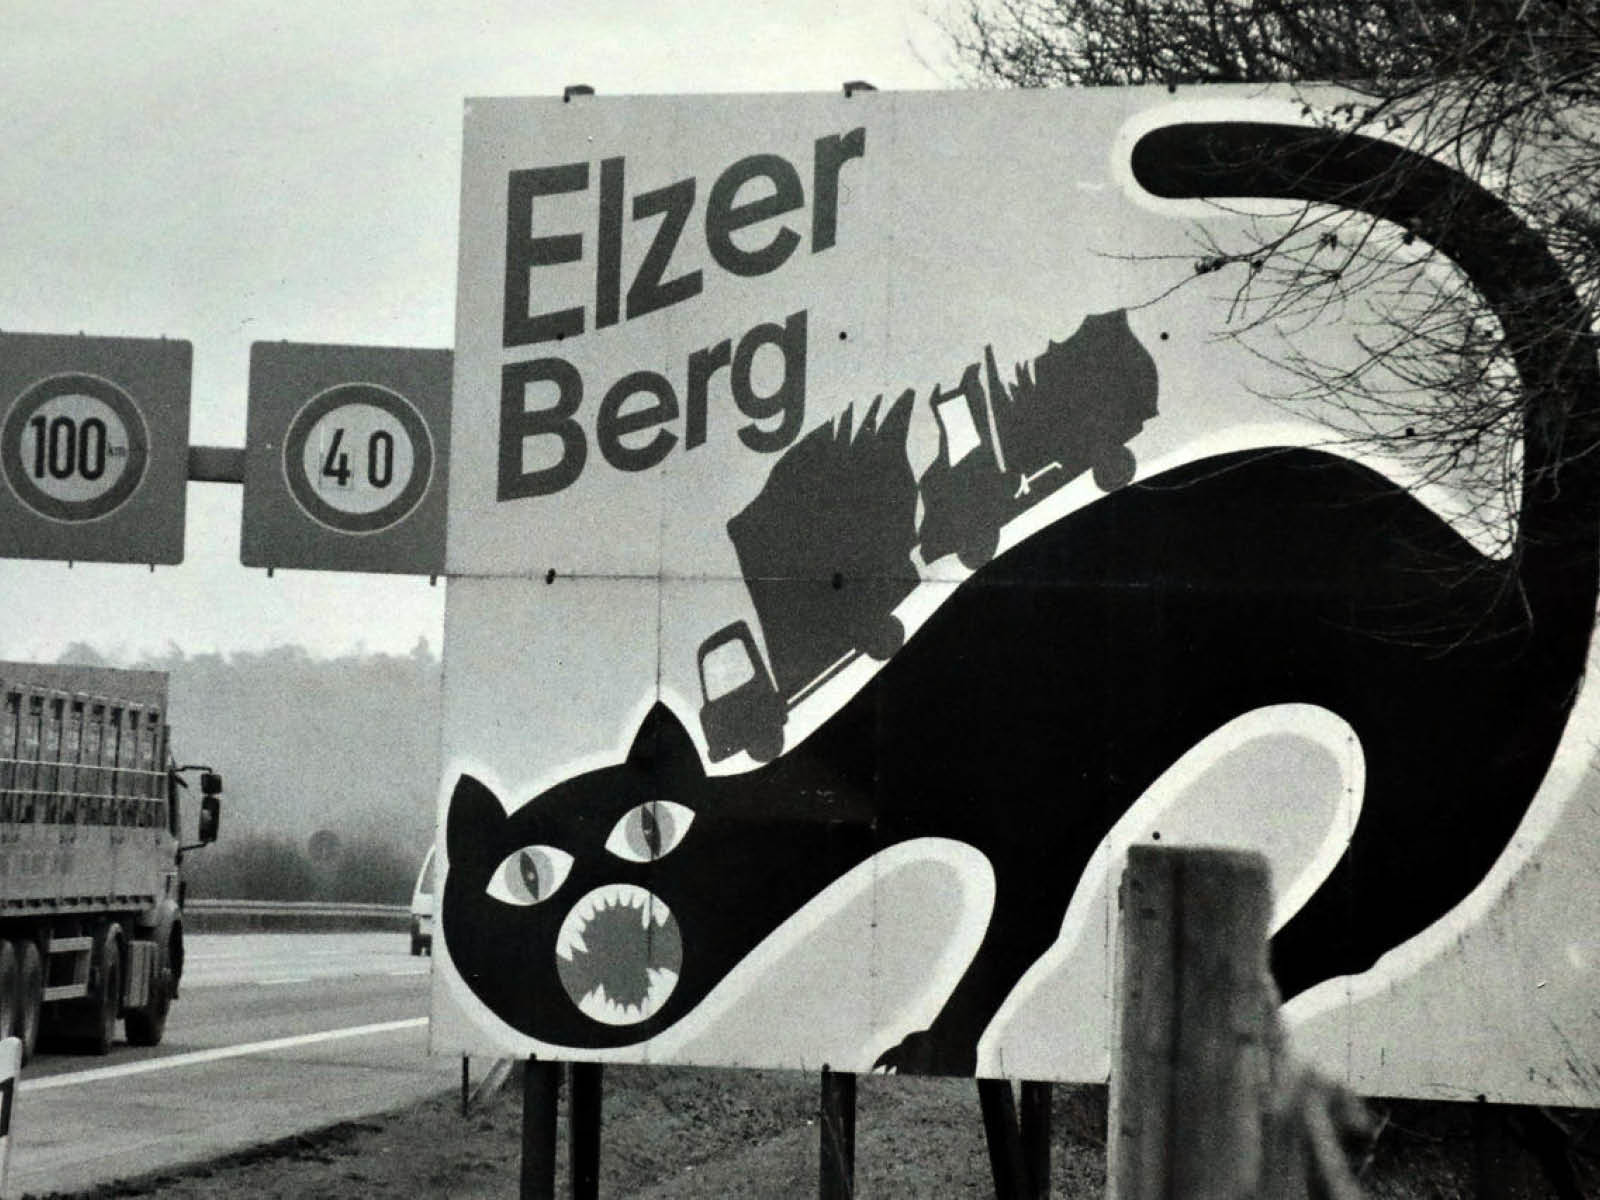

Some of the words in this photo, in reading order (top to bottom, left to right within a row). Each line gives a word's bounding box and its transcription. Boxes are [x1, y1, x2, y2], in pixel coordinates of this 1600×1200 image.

[502, 127, 866, 348] Elzer
[31, 415, 106, 480] 100
[497, 309, 808, 502] Berg
